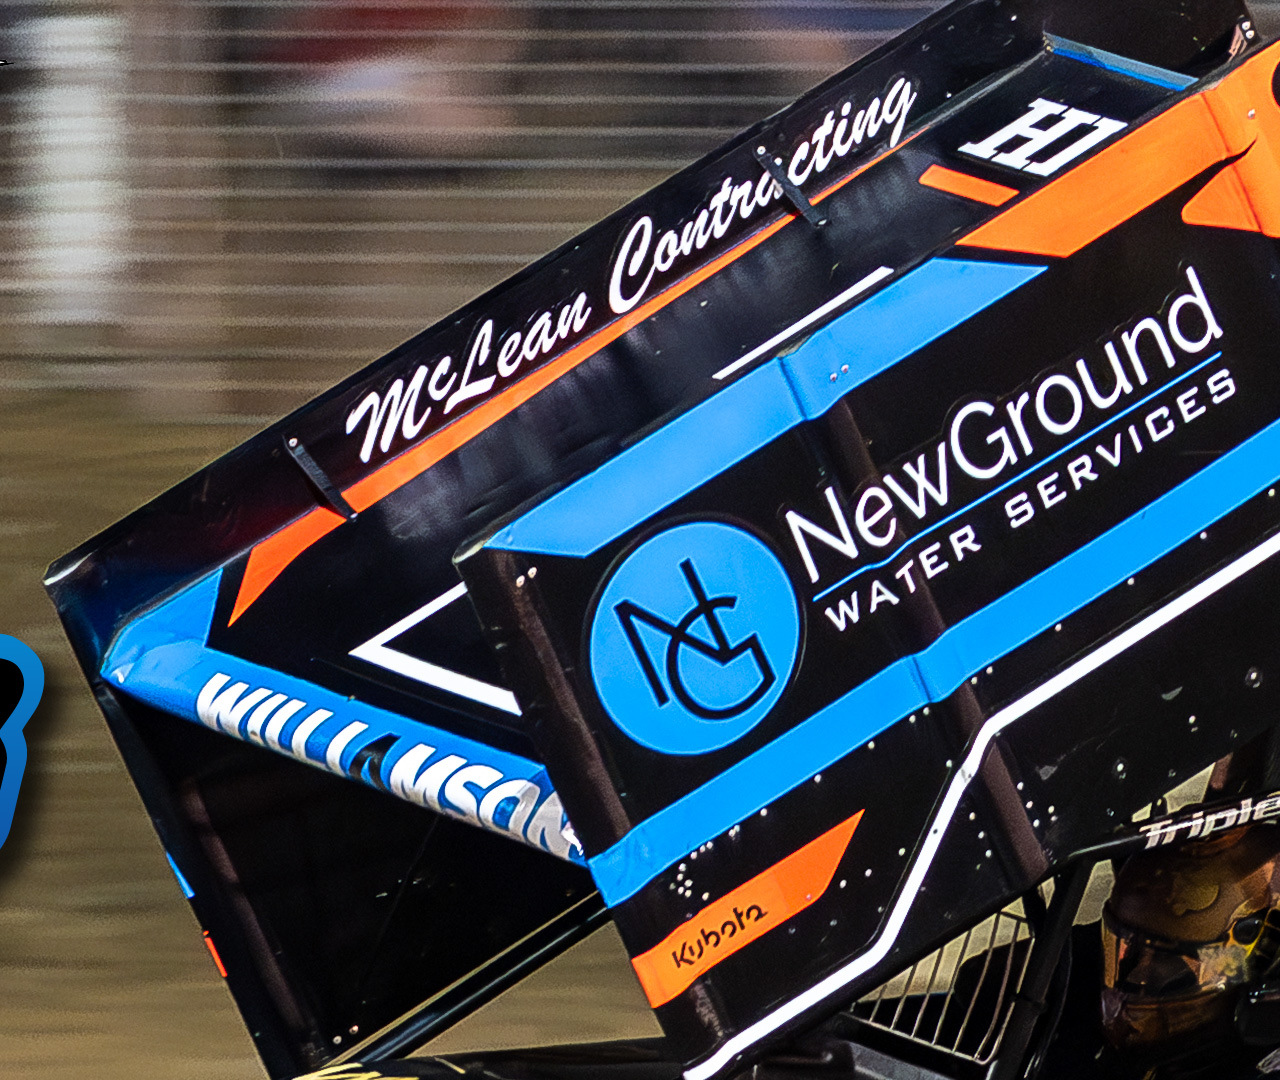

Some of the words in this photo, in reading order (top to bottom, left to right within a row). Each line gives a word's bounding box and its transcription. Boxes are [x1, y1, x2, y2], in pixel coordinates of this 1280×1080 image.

[346, 287, 591, 463] McLean
[784, 266, 1224, 583] NewGround
[824, 524, 983, 631] WATER
[1006, 369, 1236, 529] SERVICES
[672, 905, 768, 968] Kubota
